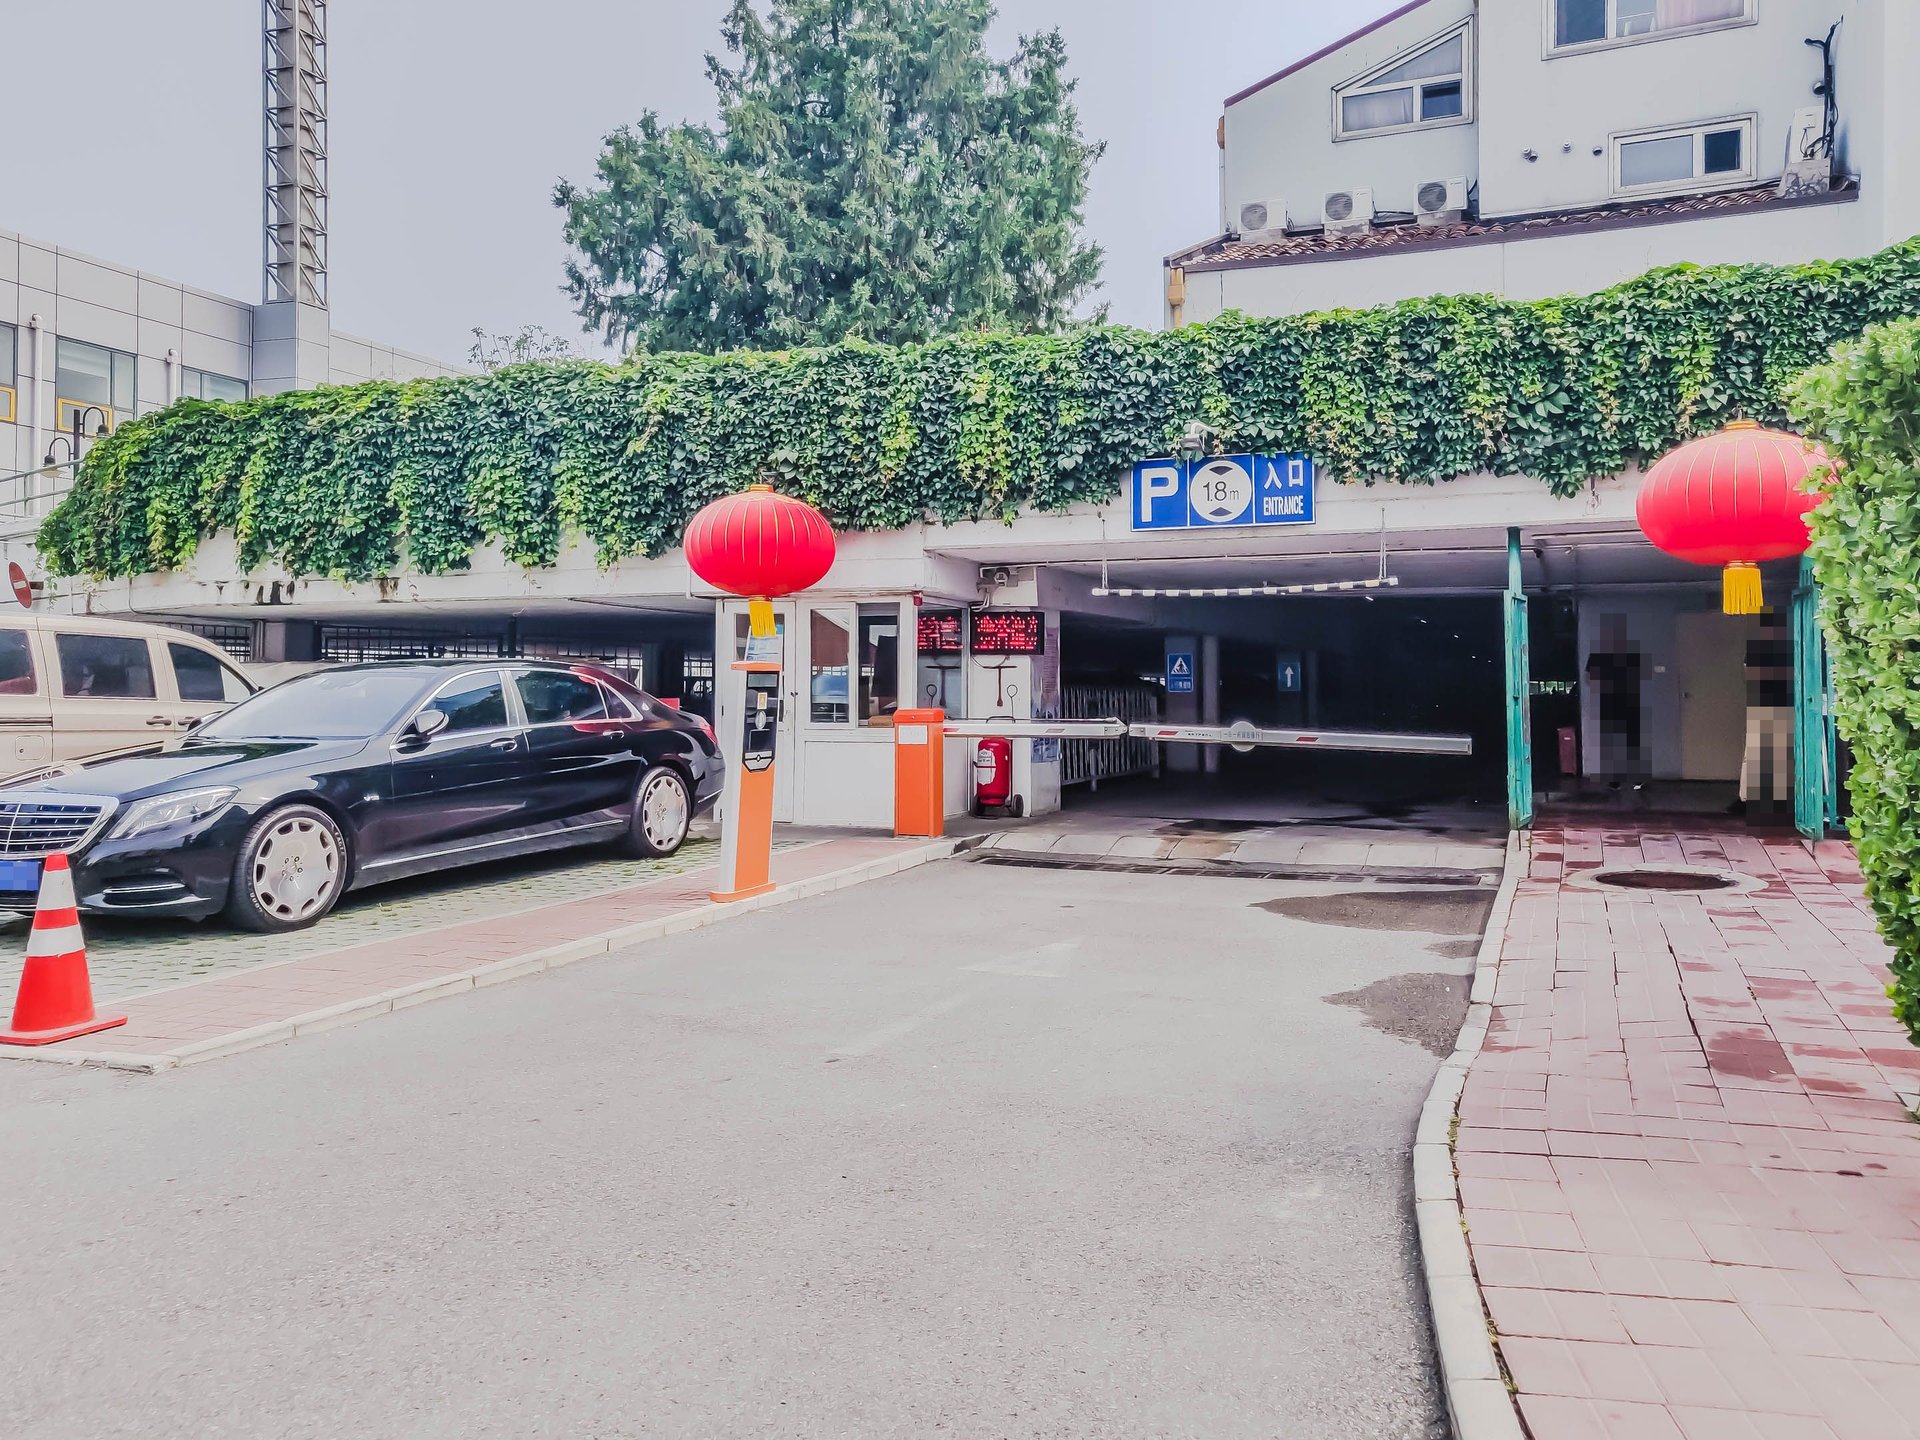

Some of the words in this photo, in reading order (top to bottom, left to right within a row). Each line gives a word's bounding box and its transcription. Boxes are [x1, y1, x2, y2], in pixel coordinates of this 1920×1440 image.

[1264, 460, 1304, 489] 入口
[1141, 467, 1179, 522] P
[1263, 495, 1304, 516] ENTRANCE
